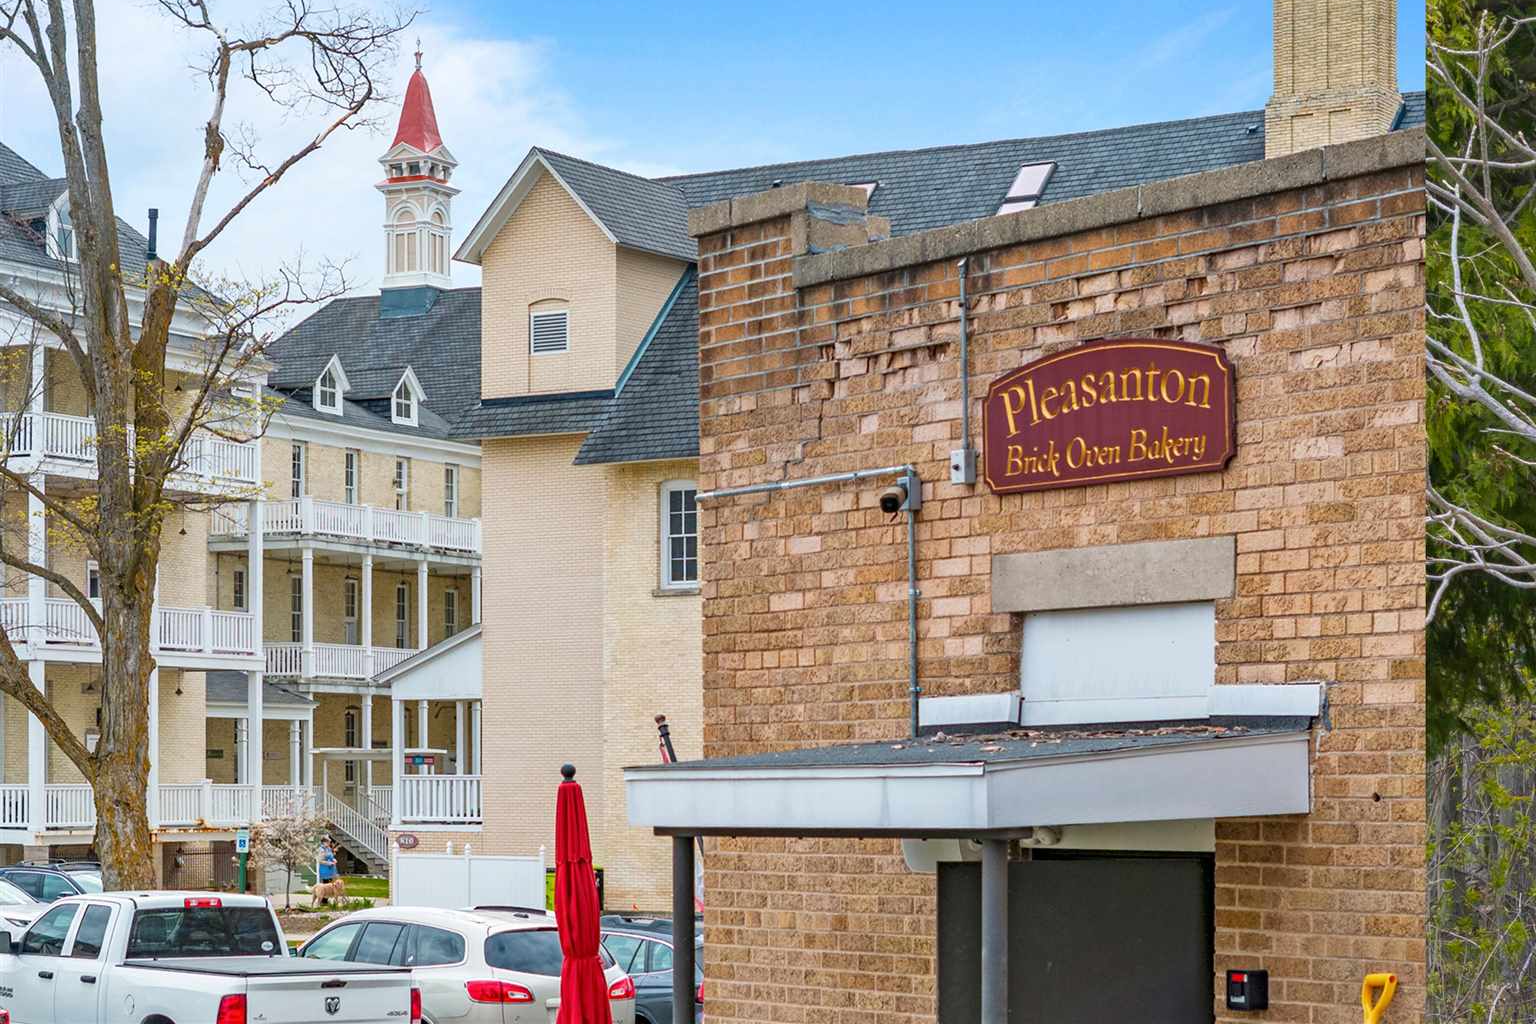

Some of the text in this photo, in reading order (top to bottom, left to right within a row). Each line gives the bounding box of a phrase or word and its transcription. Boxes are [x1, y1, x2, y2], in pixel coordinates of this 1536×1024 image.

[999, 362, 1212, 439] Pleasanton
[1005, 426, 1207, 477] Brick Oven Bakery
